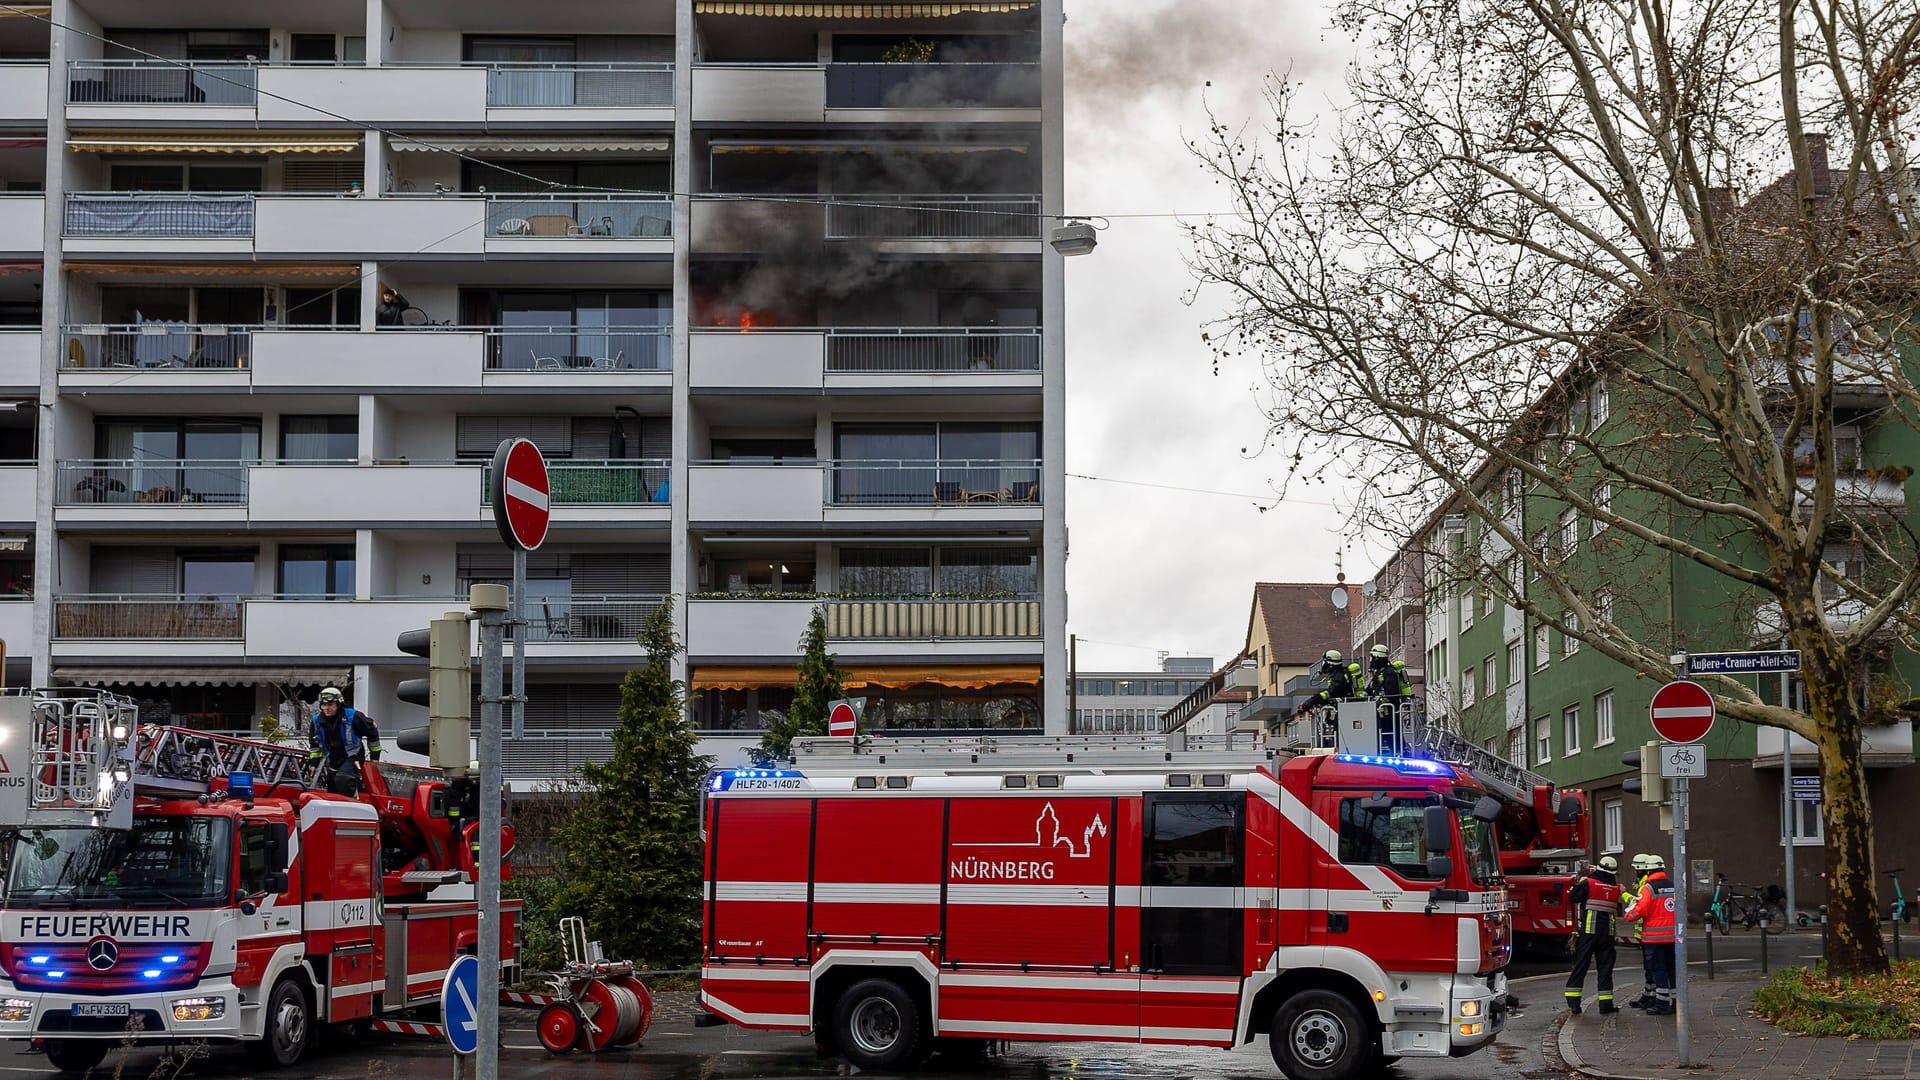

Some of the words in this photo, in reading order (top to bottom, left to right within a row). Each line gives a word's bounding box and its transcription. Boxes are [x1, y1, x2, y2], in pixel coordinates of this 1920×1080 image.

[1691, 655, 1798, 671] Äußere-Cramer-Klett-Str.
[1676, 766, 1691, 774] frei
[951, 856, 1054, 879] NÜRNBERG
[351, 904, 364, 921] 112
[20, 916, 191, 937] FEUERWEHR
[79, 1005, 85, 1015] N
